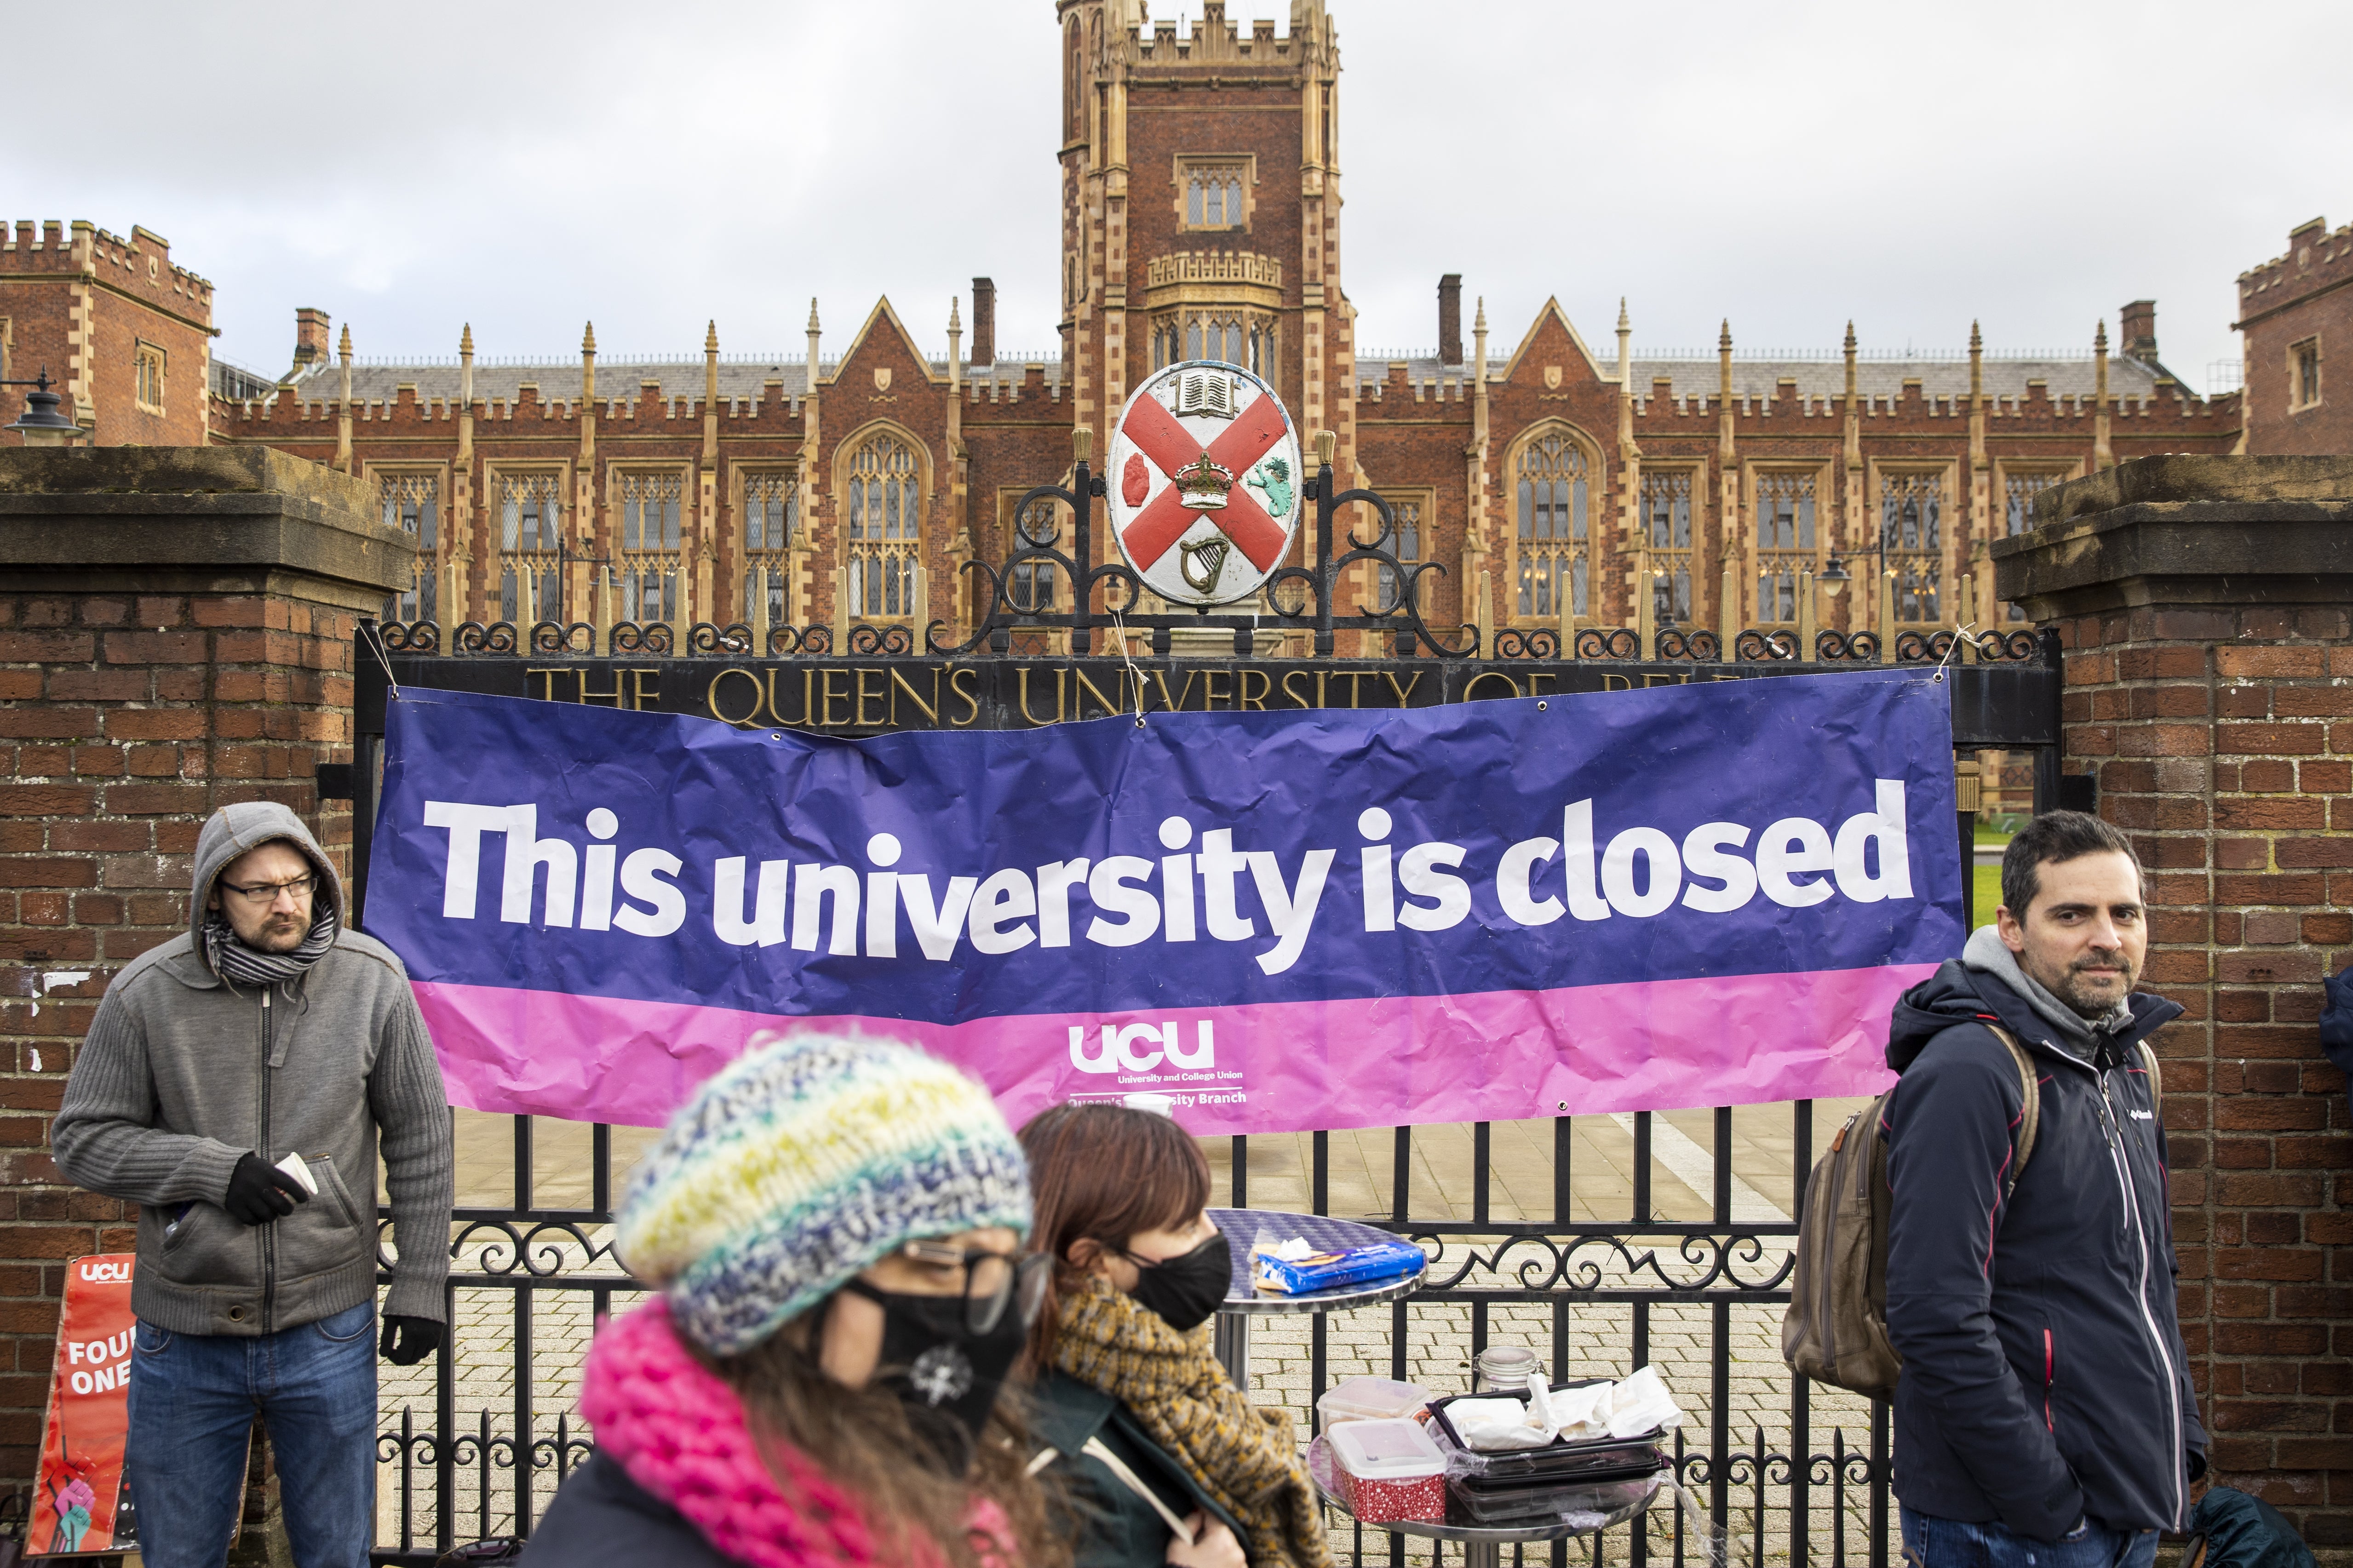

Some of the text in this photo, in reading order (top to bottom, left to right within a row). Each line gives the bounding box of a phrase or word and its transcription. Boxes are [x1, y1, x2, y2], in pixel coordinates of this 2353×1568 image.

[524, 668, 660, 711] THE
[708, 662, 978, 728] QUEEN'S
[1015, 668, 1423, 726] UNIVERSITY
[423, 778, 1915, 976] This university is closed
[1118, 1071, 1243, 1084] University and College Union
[1199, 1091, 1247, 1104] Branch
